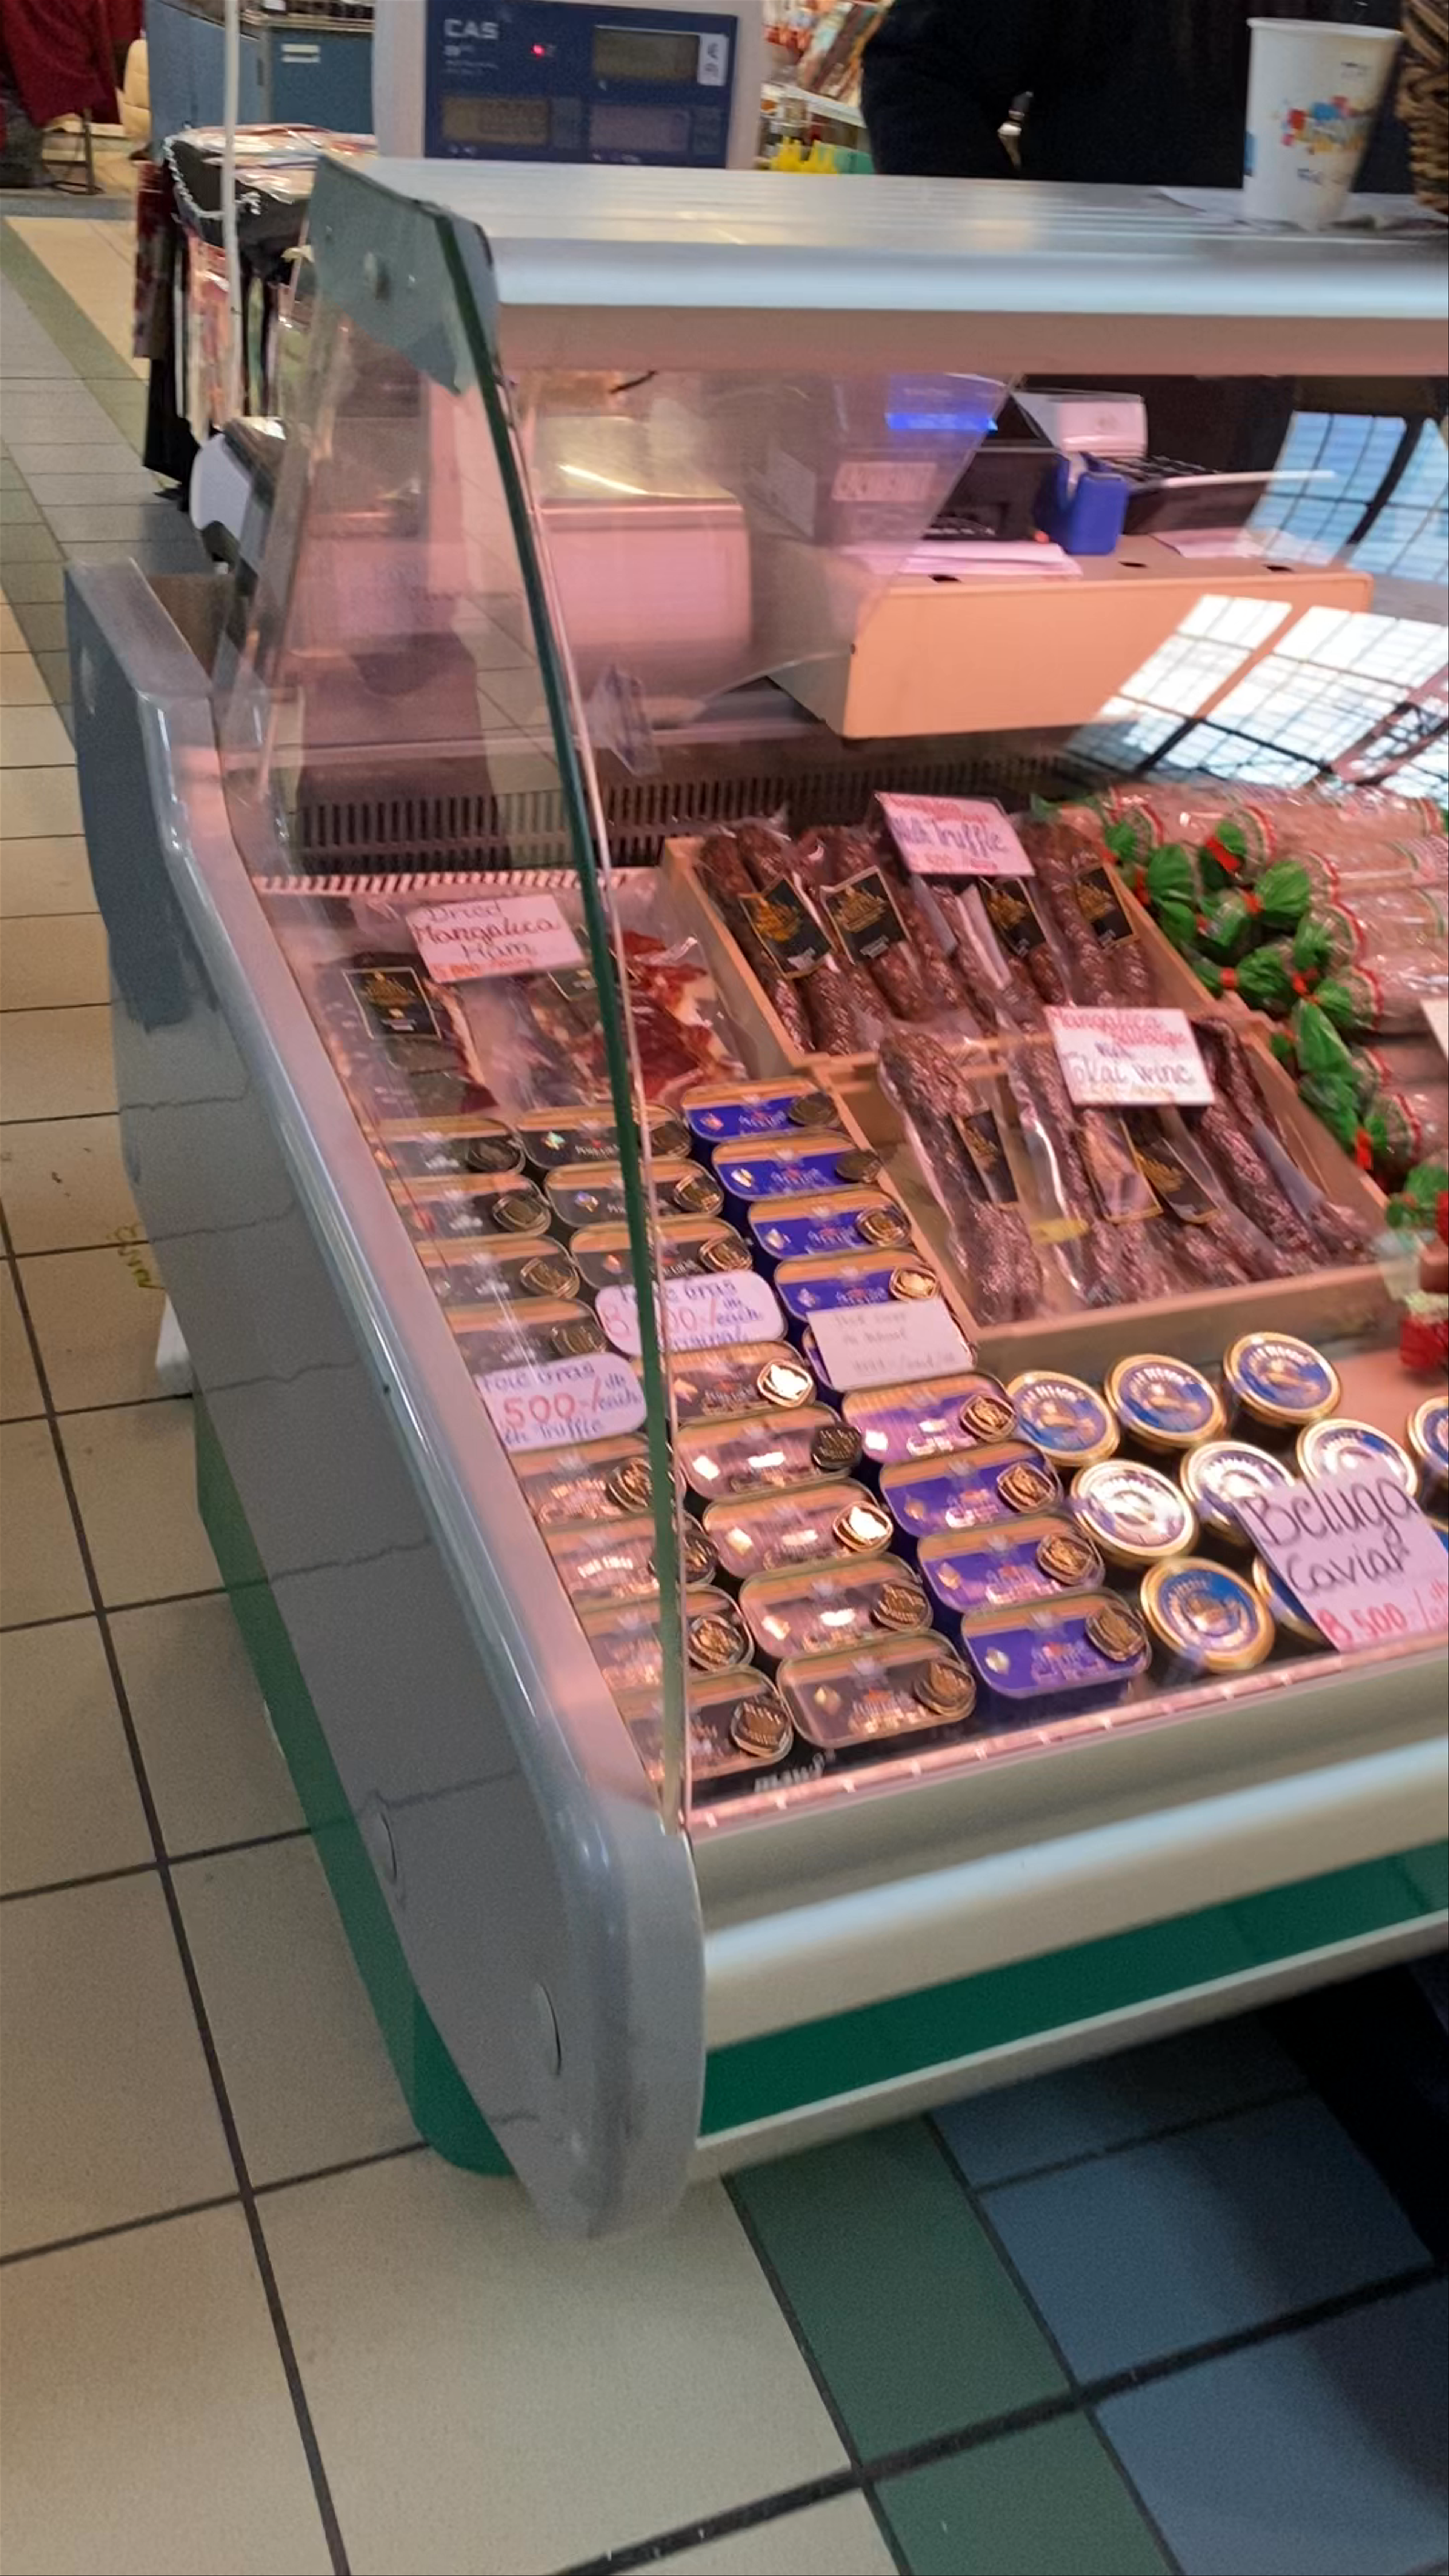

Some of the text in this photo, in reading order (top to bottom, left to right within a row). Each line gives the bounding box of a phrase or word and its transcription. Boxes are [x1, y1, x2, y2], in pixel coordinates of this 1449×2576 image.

[444, 19, 499, 39] CAS
[424, 899, 502, 923] Dried
[412, 917, 560, 944] Mangalica
[461, 941, 535, 963] Ham
[1238, 1476, 1418, 1547] Beluga
[1287, 1541, 1410, 1595] Caviar
